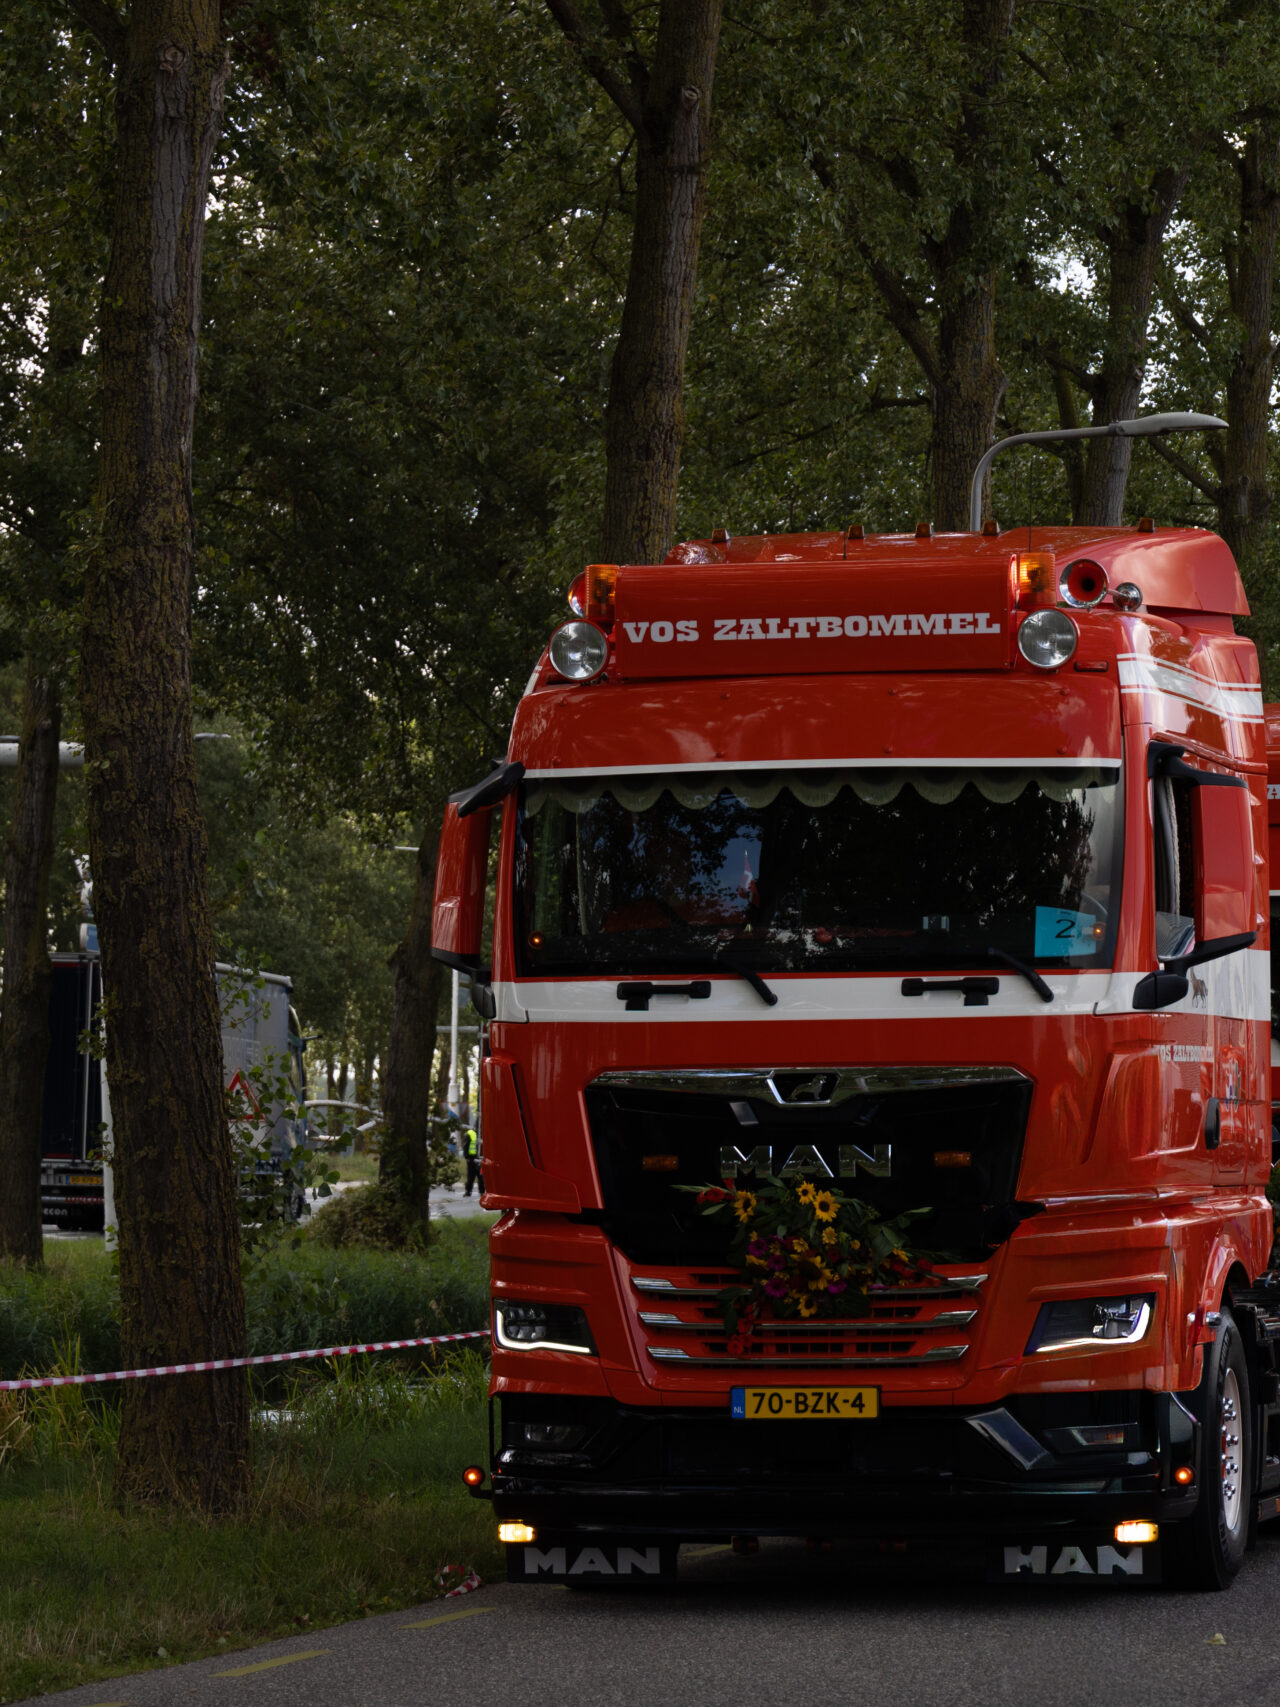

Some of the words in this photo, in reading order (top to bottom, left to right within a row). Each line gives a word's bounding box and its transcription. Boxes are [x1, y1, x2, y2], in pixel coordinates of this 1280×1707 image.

[623, 621, 699, 643] VOS
[713, 612, 1001, 641] ZALTBOMMEL
[1055, 918, 1076, 939] 2
[720, 1145, 891, 1178] MAN
[752, 1392, 866, 1414] 70-BZK-4
[524, 1547, 661, 1575] MAN
